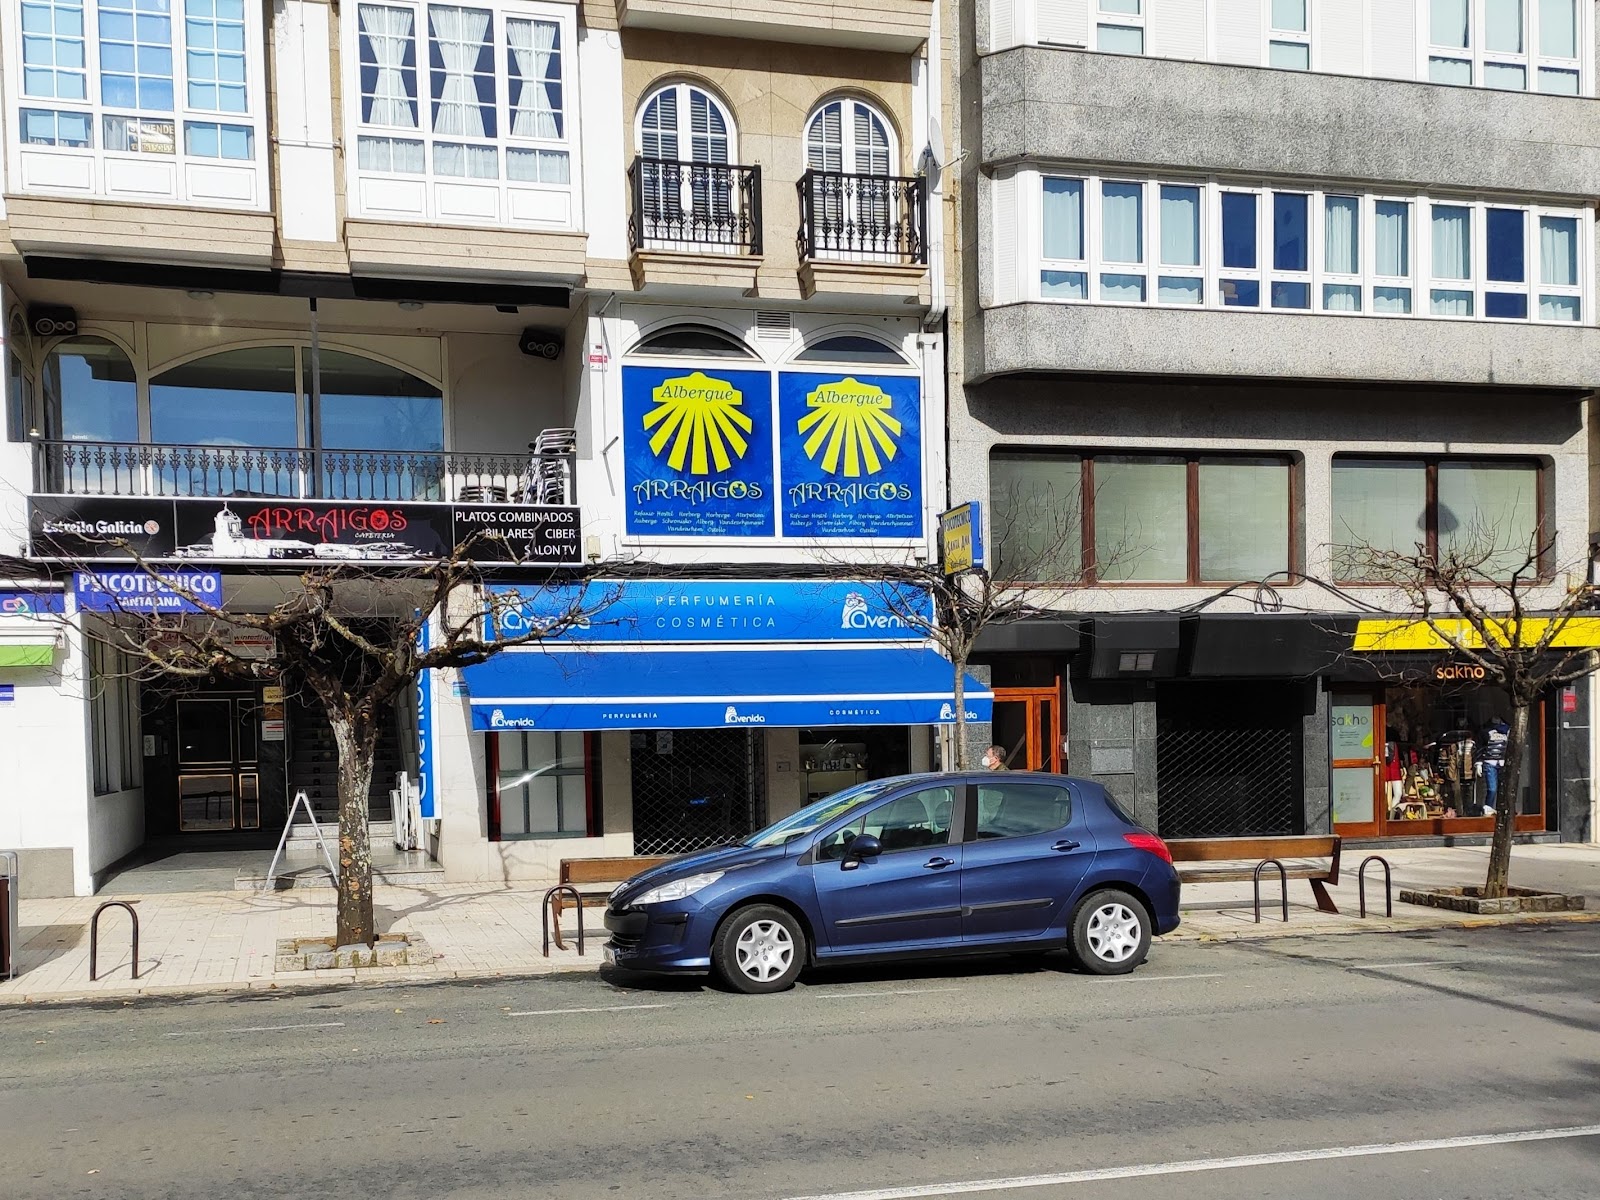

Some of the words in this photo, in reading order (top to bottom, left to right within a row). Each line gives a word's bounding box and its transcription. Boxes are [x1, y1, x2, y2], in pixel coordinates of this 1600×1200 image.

[660, 385, 734, 402] Albergue
[815, 390, 883, 407] Albergue
[633, 479, 763, 506] ARRAIGOS
[789, 482, 912, 508] ARRAIGOS
[455, 511, 497, 522] PLATOS
[498, 511, 574, 523] COMBINADOS
[96, 520, 143, 534] Galicia
[248, 507, 407, 543] ARRAIGOS
[485, 528, 534, 539] BILLARES
[544, 528, 576, 539] CIBER
[561, 544, 577, 555] TV
[115, 596, 153, 607] SANTA
[156, 597, 181, 607] ANA
[656, 594, 776, 606] PERFUMERÍA
[502, 610, 591, 630] avena
[656, 614, 776, 628] COSMÉTICA
[850, 610, 928, 629] avenia
[1436, 664, 1485, 679] sakho
[944, 710, 978, 720] avida
[1331, 713, 1369, 727] sakho
